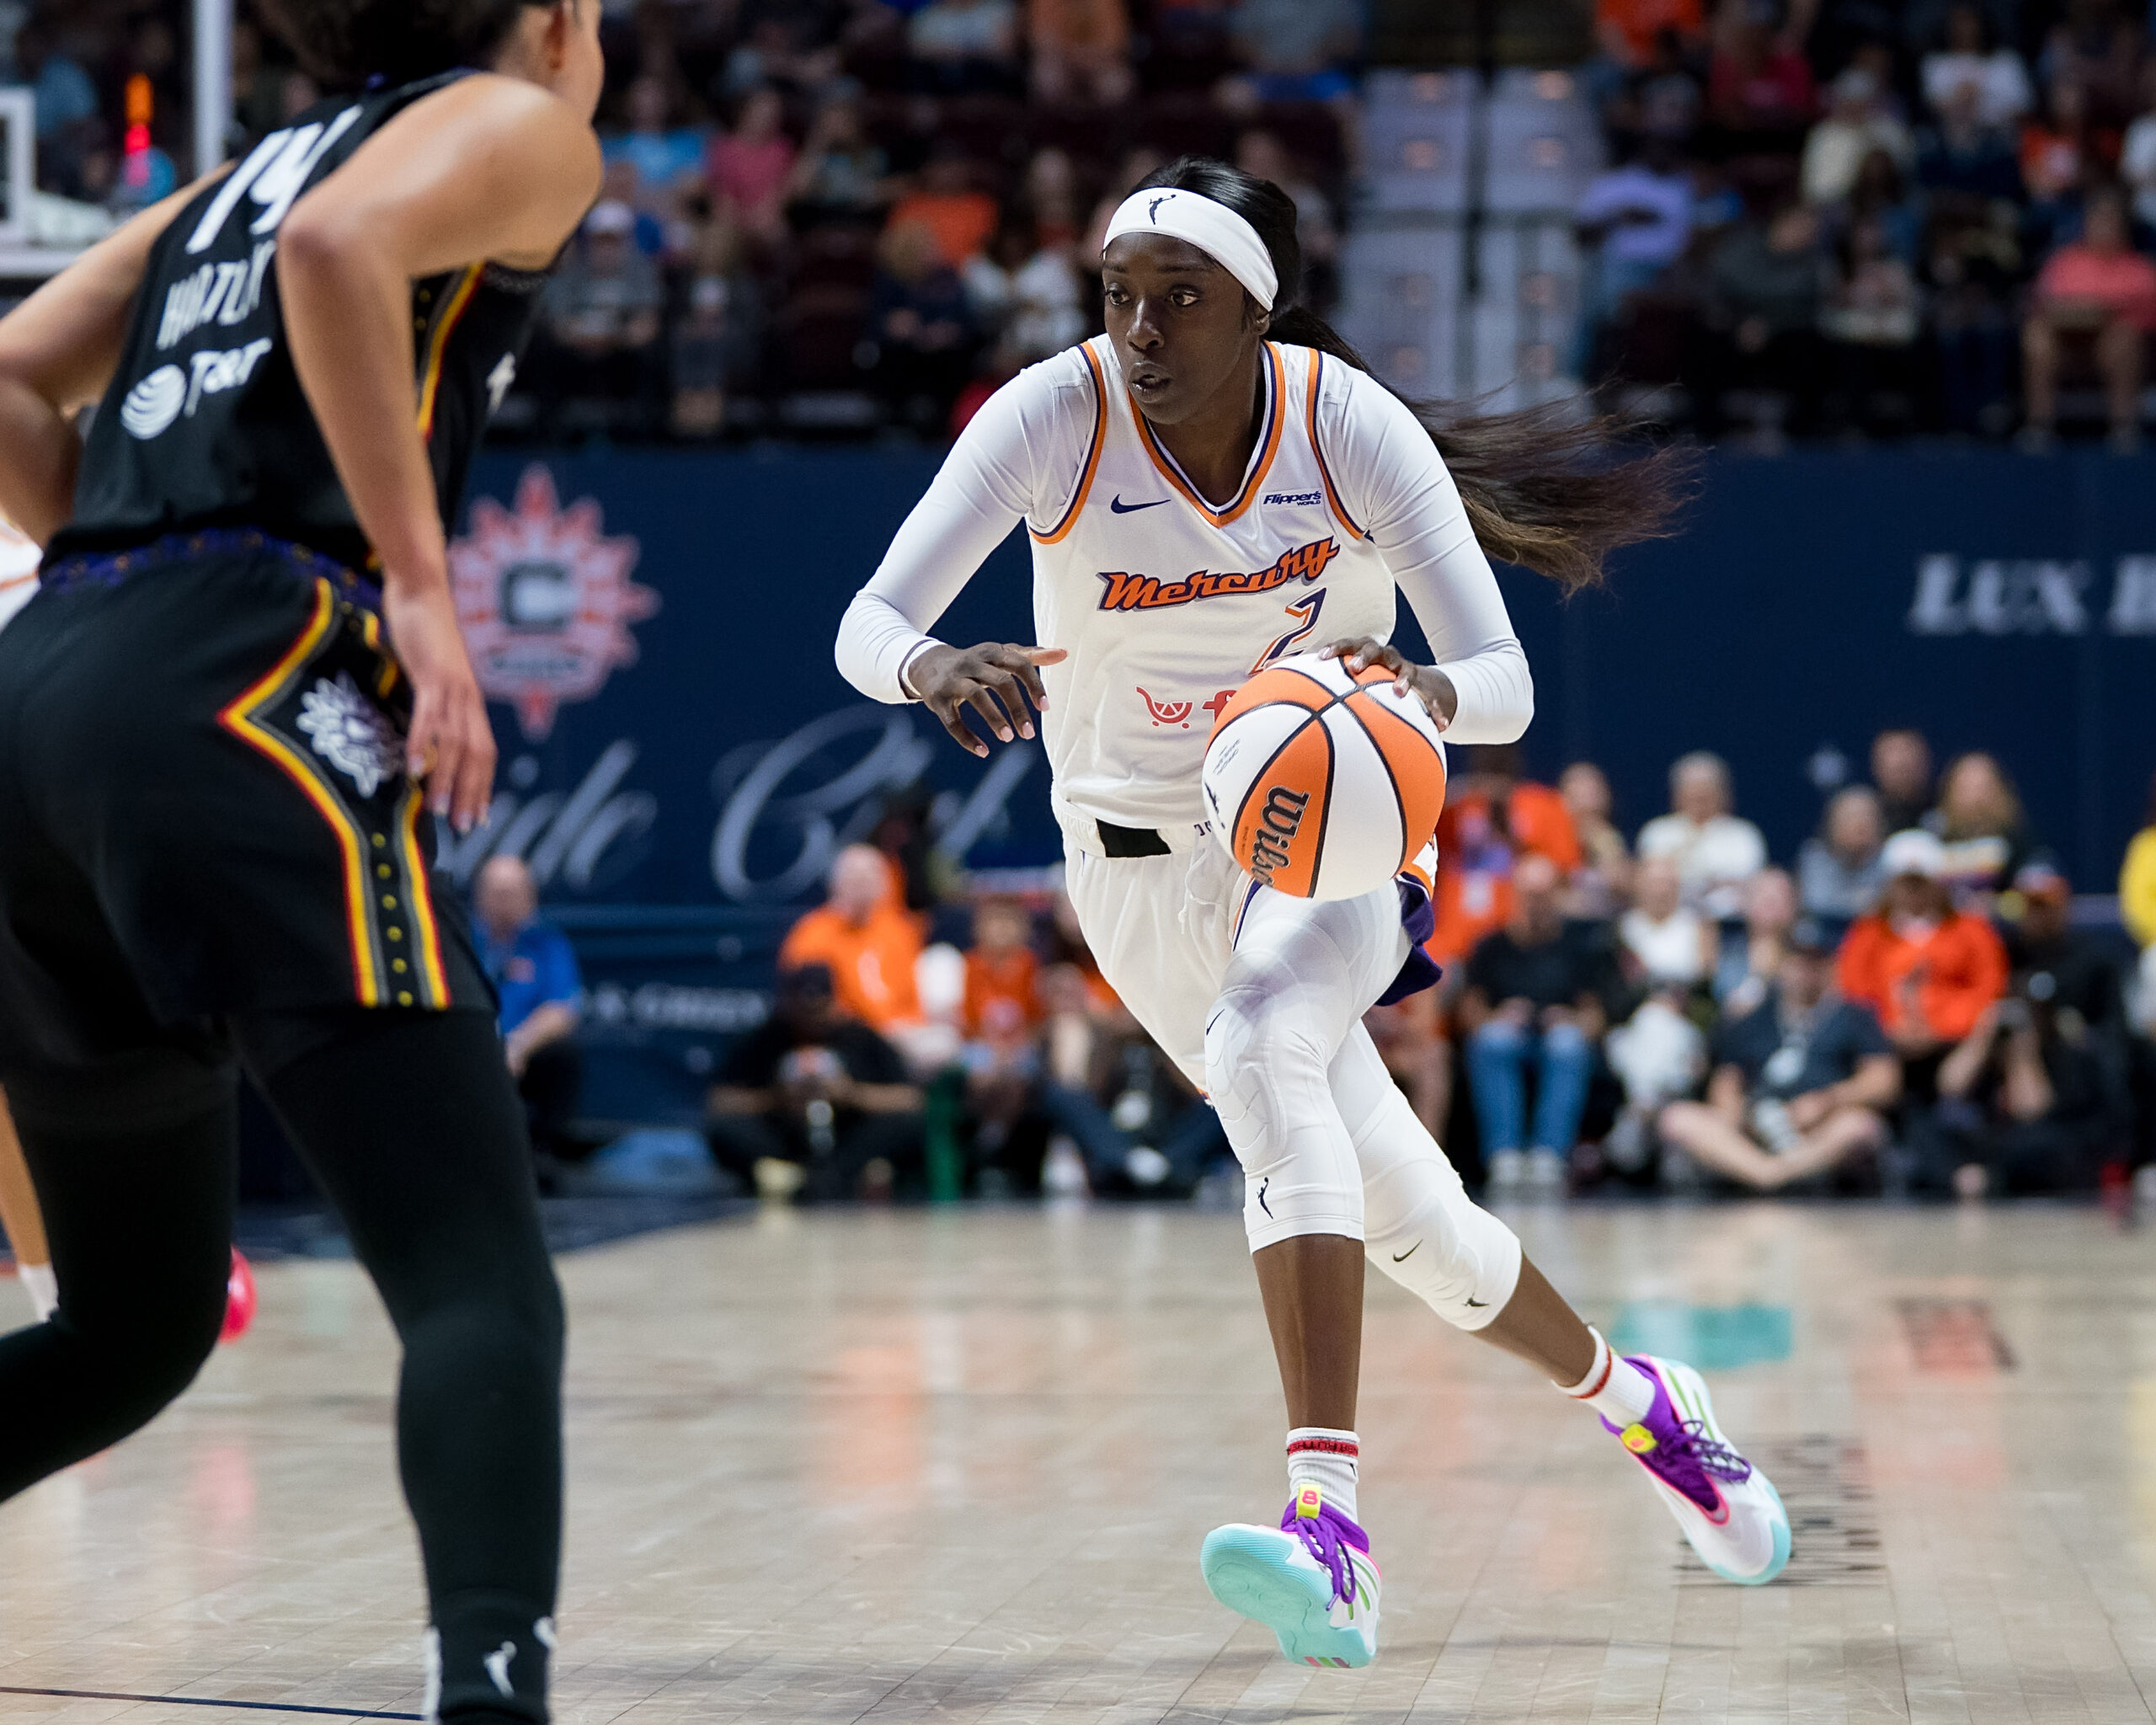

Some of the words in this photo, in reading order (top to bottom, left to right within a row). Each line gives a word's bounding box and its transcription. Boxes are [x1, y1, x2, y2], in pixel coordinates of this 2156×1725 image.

[1263, 491, 1321, 505] Flipper's
[1096, 536, 1340, 612] Mercury
[1908, 553, 2093, 637] LUX
[1247, 587, 1327, 676] 2
[1251, 785, 1311, 888] Wilso
